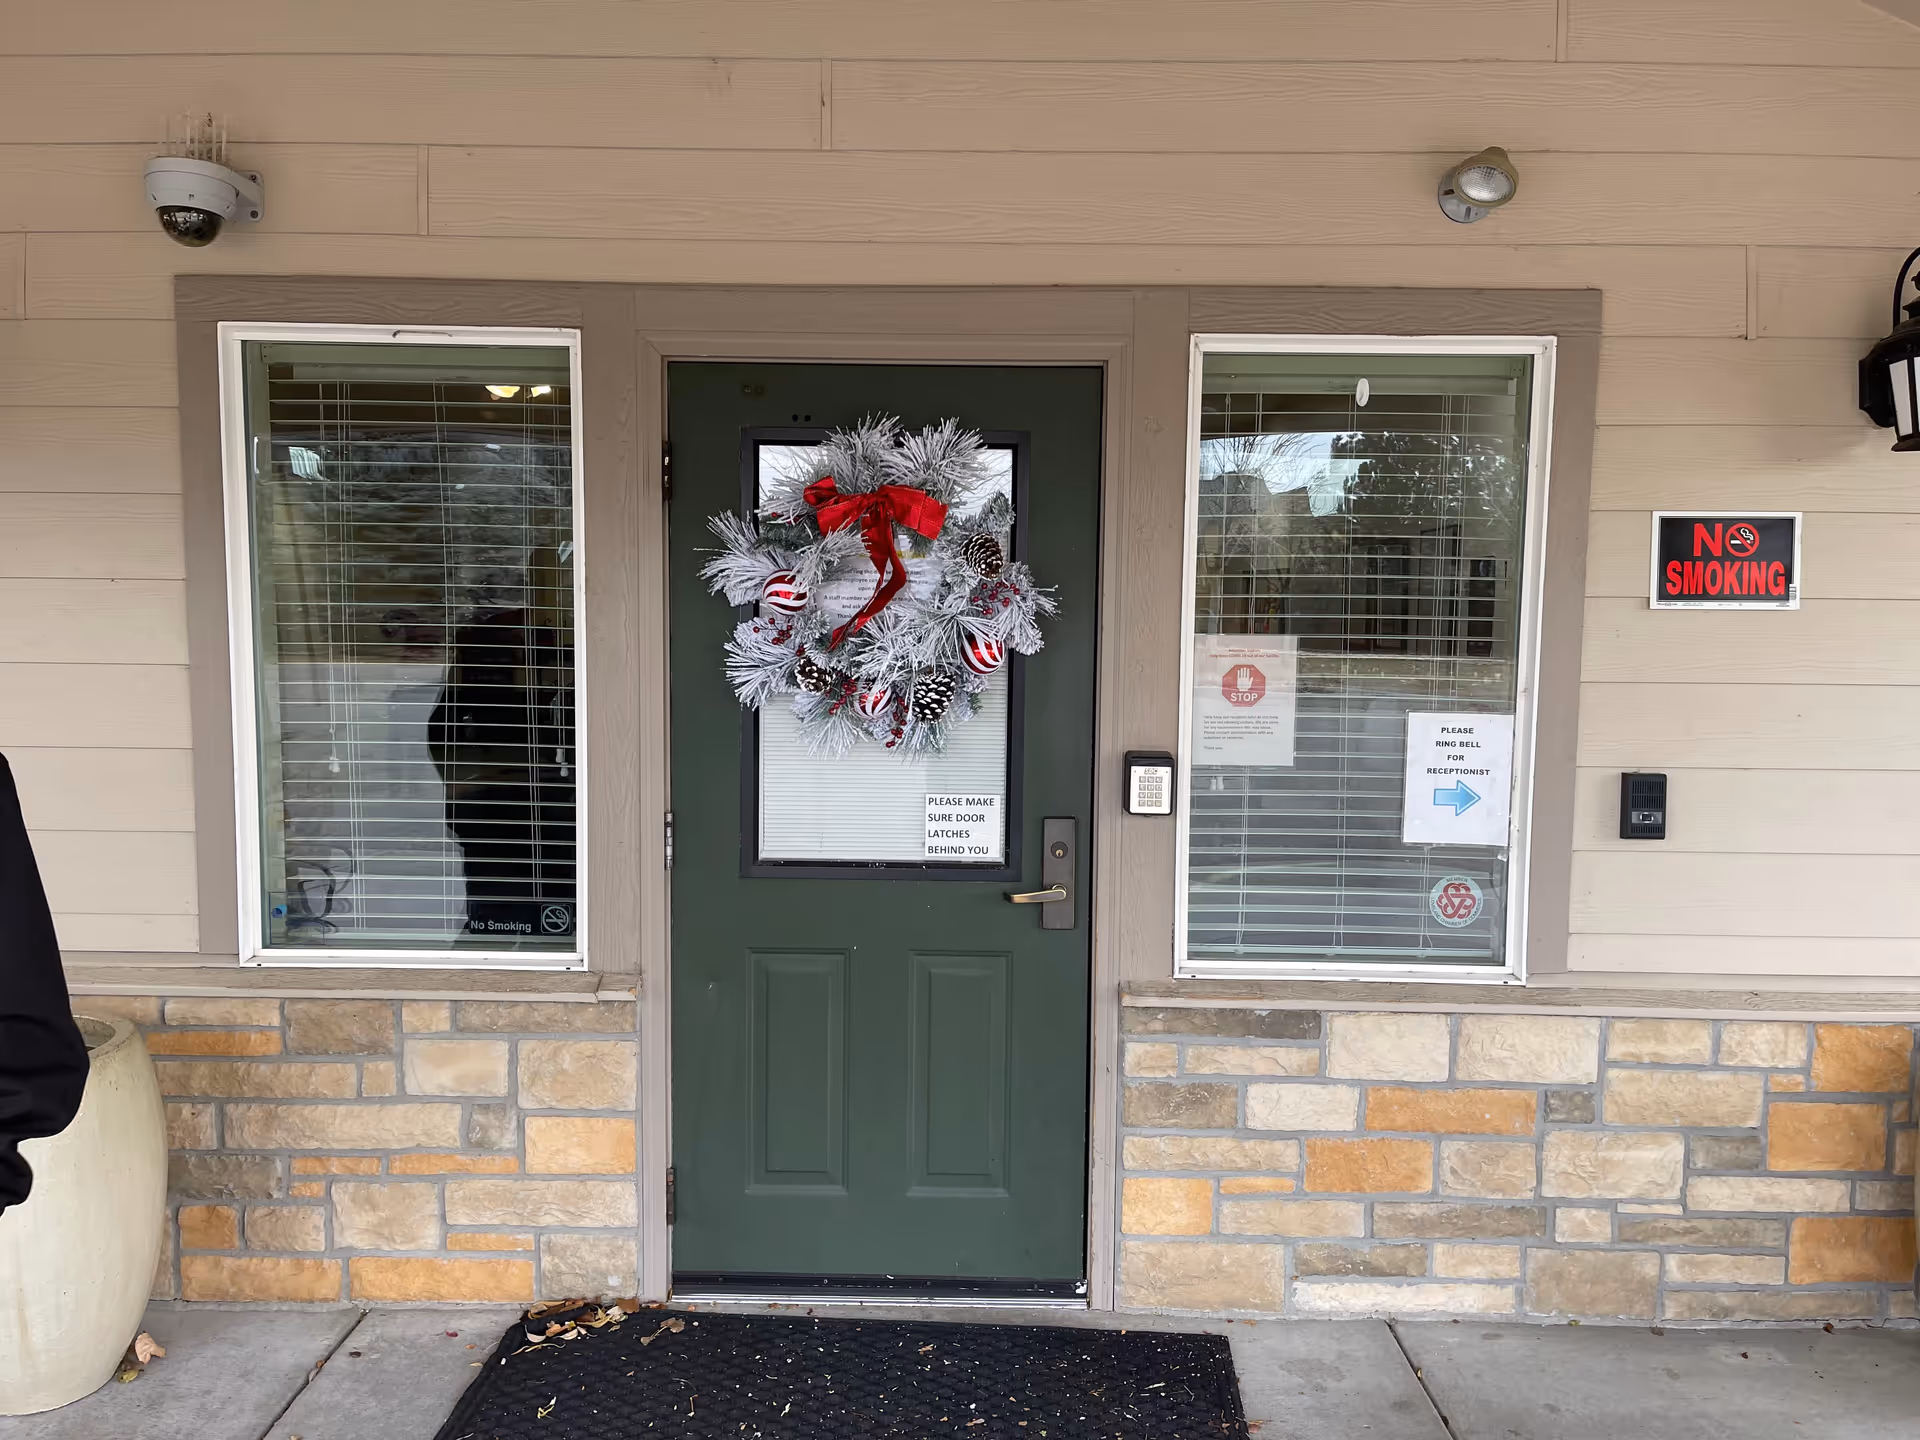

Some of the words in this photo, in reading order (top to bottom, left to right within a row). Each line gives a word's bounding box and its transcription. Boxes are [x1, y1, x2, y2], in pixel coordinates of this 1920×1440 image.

[1666, 560, 1785, 596] SMOKING
[1231, 693, 1258, 702] STOP
[928, 797, 963, 806] PLEASE
[966, 798, 995, 806] MAKE
[928, 813, 953, 822] SURE
[956, 814, 985, 822] DOOR
[928, 829, 970, 838] LATCHES
[928, 846, 965, 854] BEHIND
[967, 846, 989, 854] YOU
[471, 920, 485, 929] No
[487, 921, 531, 932] Smoking
